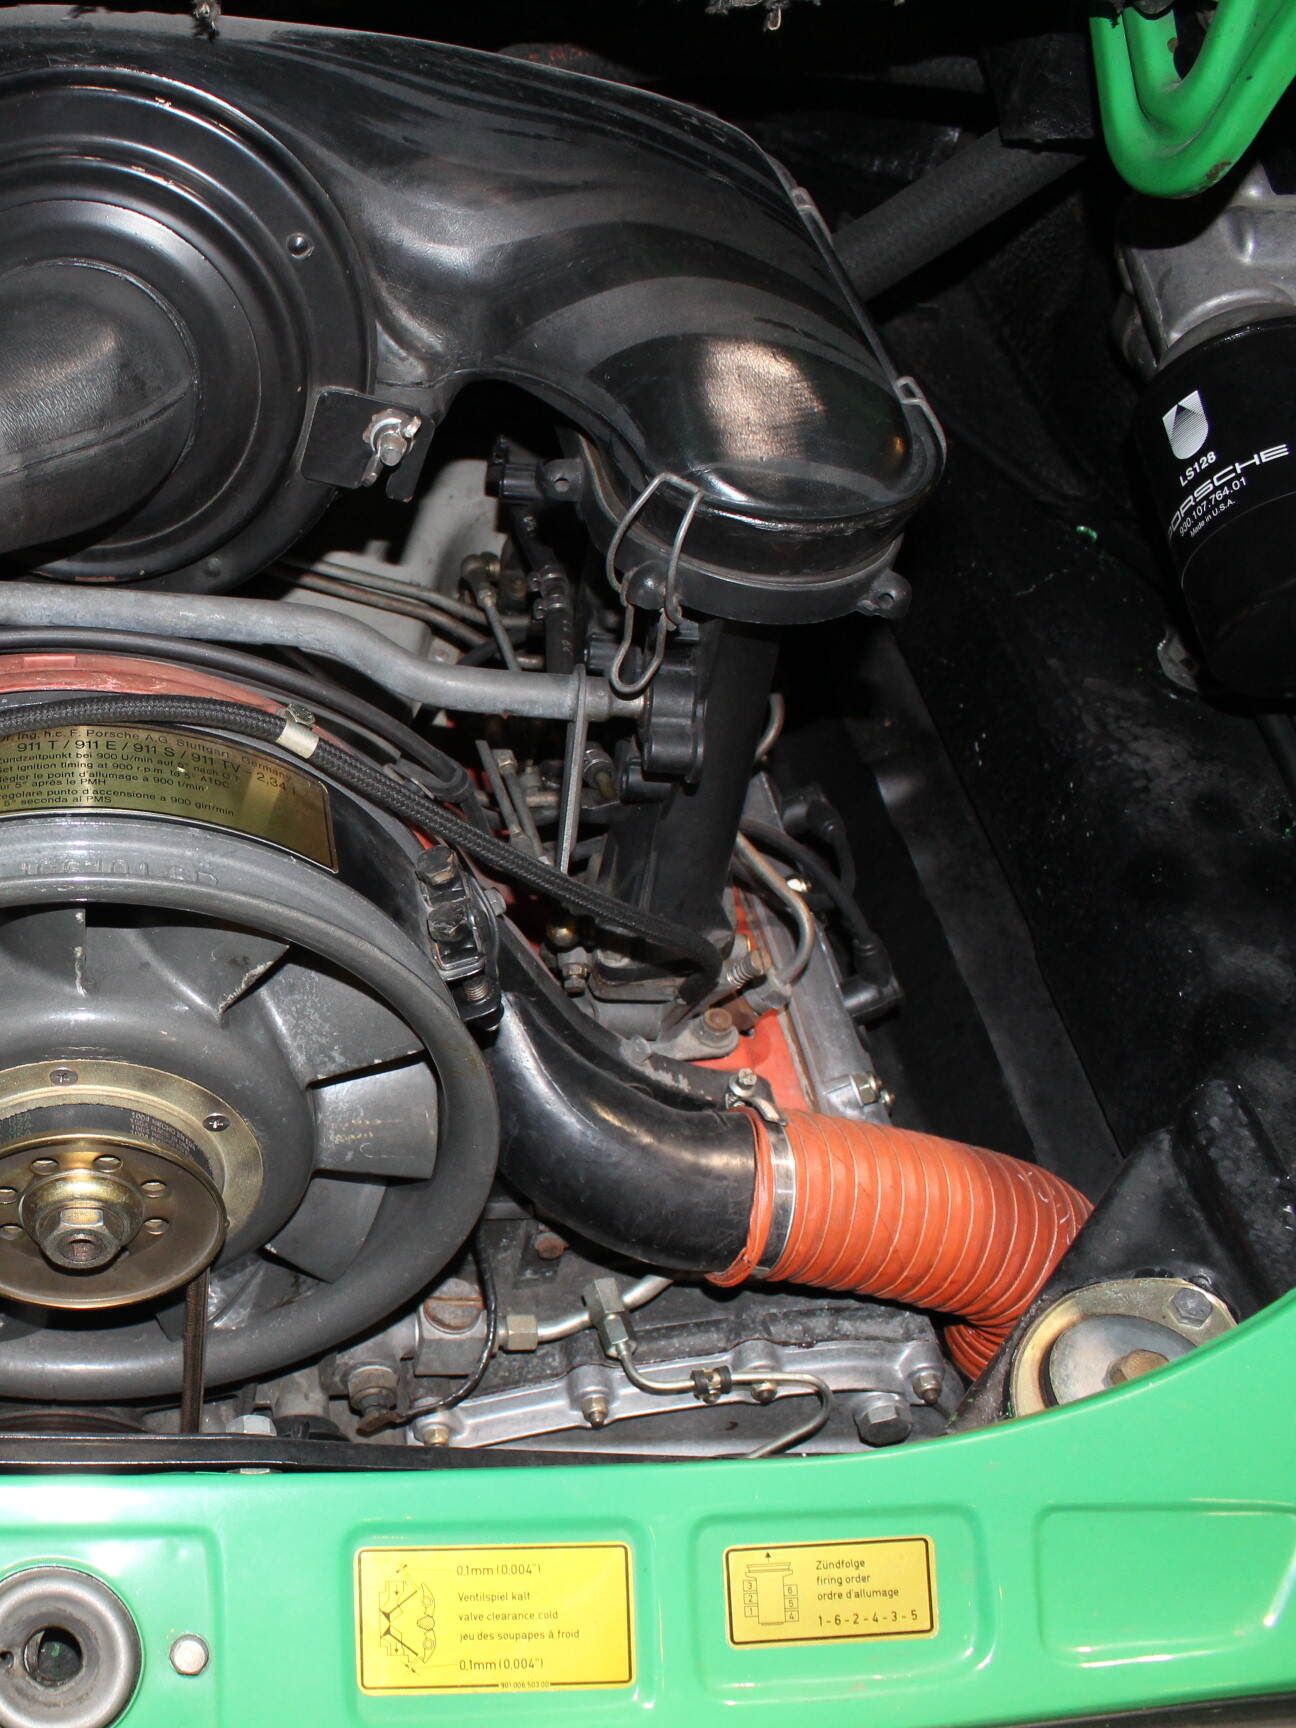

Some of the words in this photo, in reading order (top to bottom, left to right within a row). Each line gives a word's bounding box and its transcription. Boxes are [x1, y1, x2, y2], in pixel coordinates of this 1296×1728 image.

[1179, 451, 1216, 487] LS128
[1179, 477, 1246, 536] 930.107.764.01
[1190, 519, 1206, 537] Made
[1205, 513, 1212, 522] in
[1211, 499, 1236, 517] U.S.A.
[87, 729, 140, 741] Porsche
[17, 741, 41, 752] 911
[48, 740, 58, 750] T
[63, 740, 70, 749] /
[75, 740, 98, 750] 911
[106, 741, 117, 750] E
[122, 742, 128, 751] /
[133, 743, 157, 755] 911
[164, 747, 175, 758] S
[180, 751, 186, 759] /
[191, 752, 214, 766] 911
[121, 754, 153, 764] U/min
[157, 758, 174, 767] auf
[18, 763, 57, 772] ignition
[61, 762, 94, 770] timing
[112, 763, 134, 771] 900
[47, 771, 75, 780] point
[153, 776, 174, 785] 900
[80, 778, 106, 786] PMH
[21, 796, 68, 805] seconda
[47, 788, 78, 797] punto
[171, 796, 192, 806] 900
[747, 1582, 753, 1590] 3
[817, 1575, 843, 1586] firing
[846, 1574, 871, 1584] order
[787, 1586, 793, 1594] 6
[817, 1591, 843, 1601] ordre
[846, 1588, 899, 1600] d'allumage
[458, 1592, 508, 1604] Ventilspiel
[511, 1592, 530, 1601] kalt
[747, 1594, 753, 1603] 2
[788, 1599, 794, 1608] 5
[458, 1611, 485, 1621] valve
[486, 1610, 535, 1621] clearance
[538, 1609, 559, 1620] cold
[789, 1612, 795, 1621] 4
[459, 1631, 475, 1643] jeu
[477, 1631, 495, 1641] des
[497, 1631, 546, 1643] soupapes
[557, 1628, 580, 1639] froid
